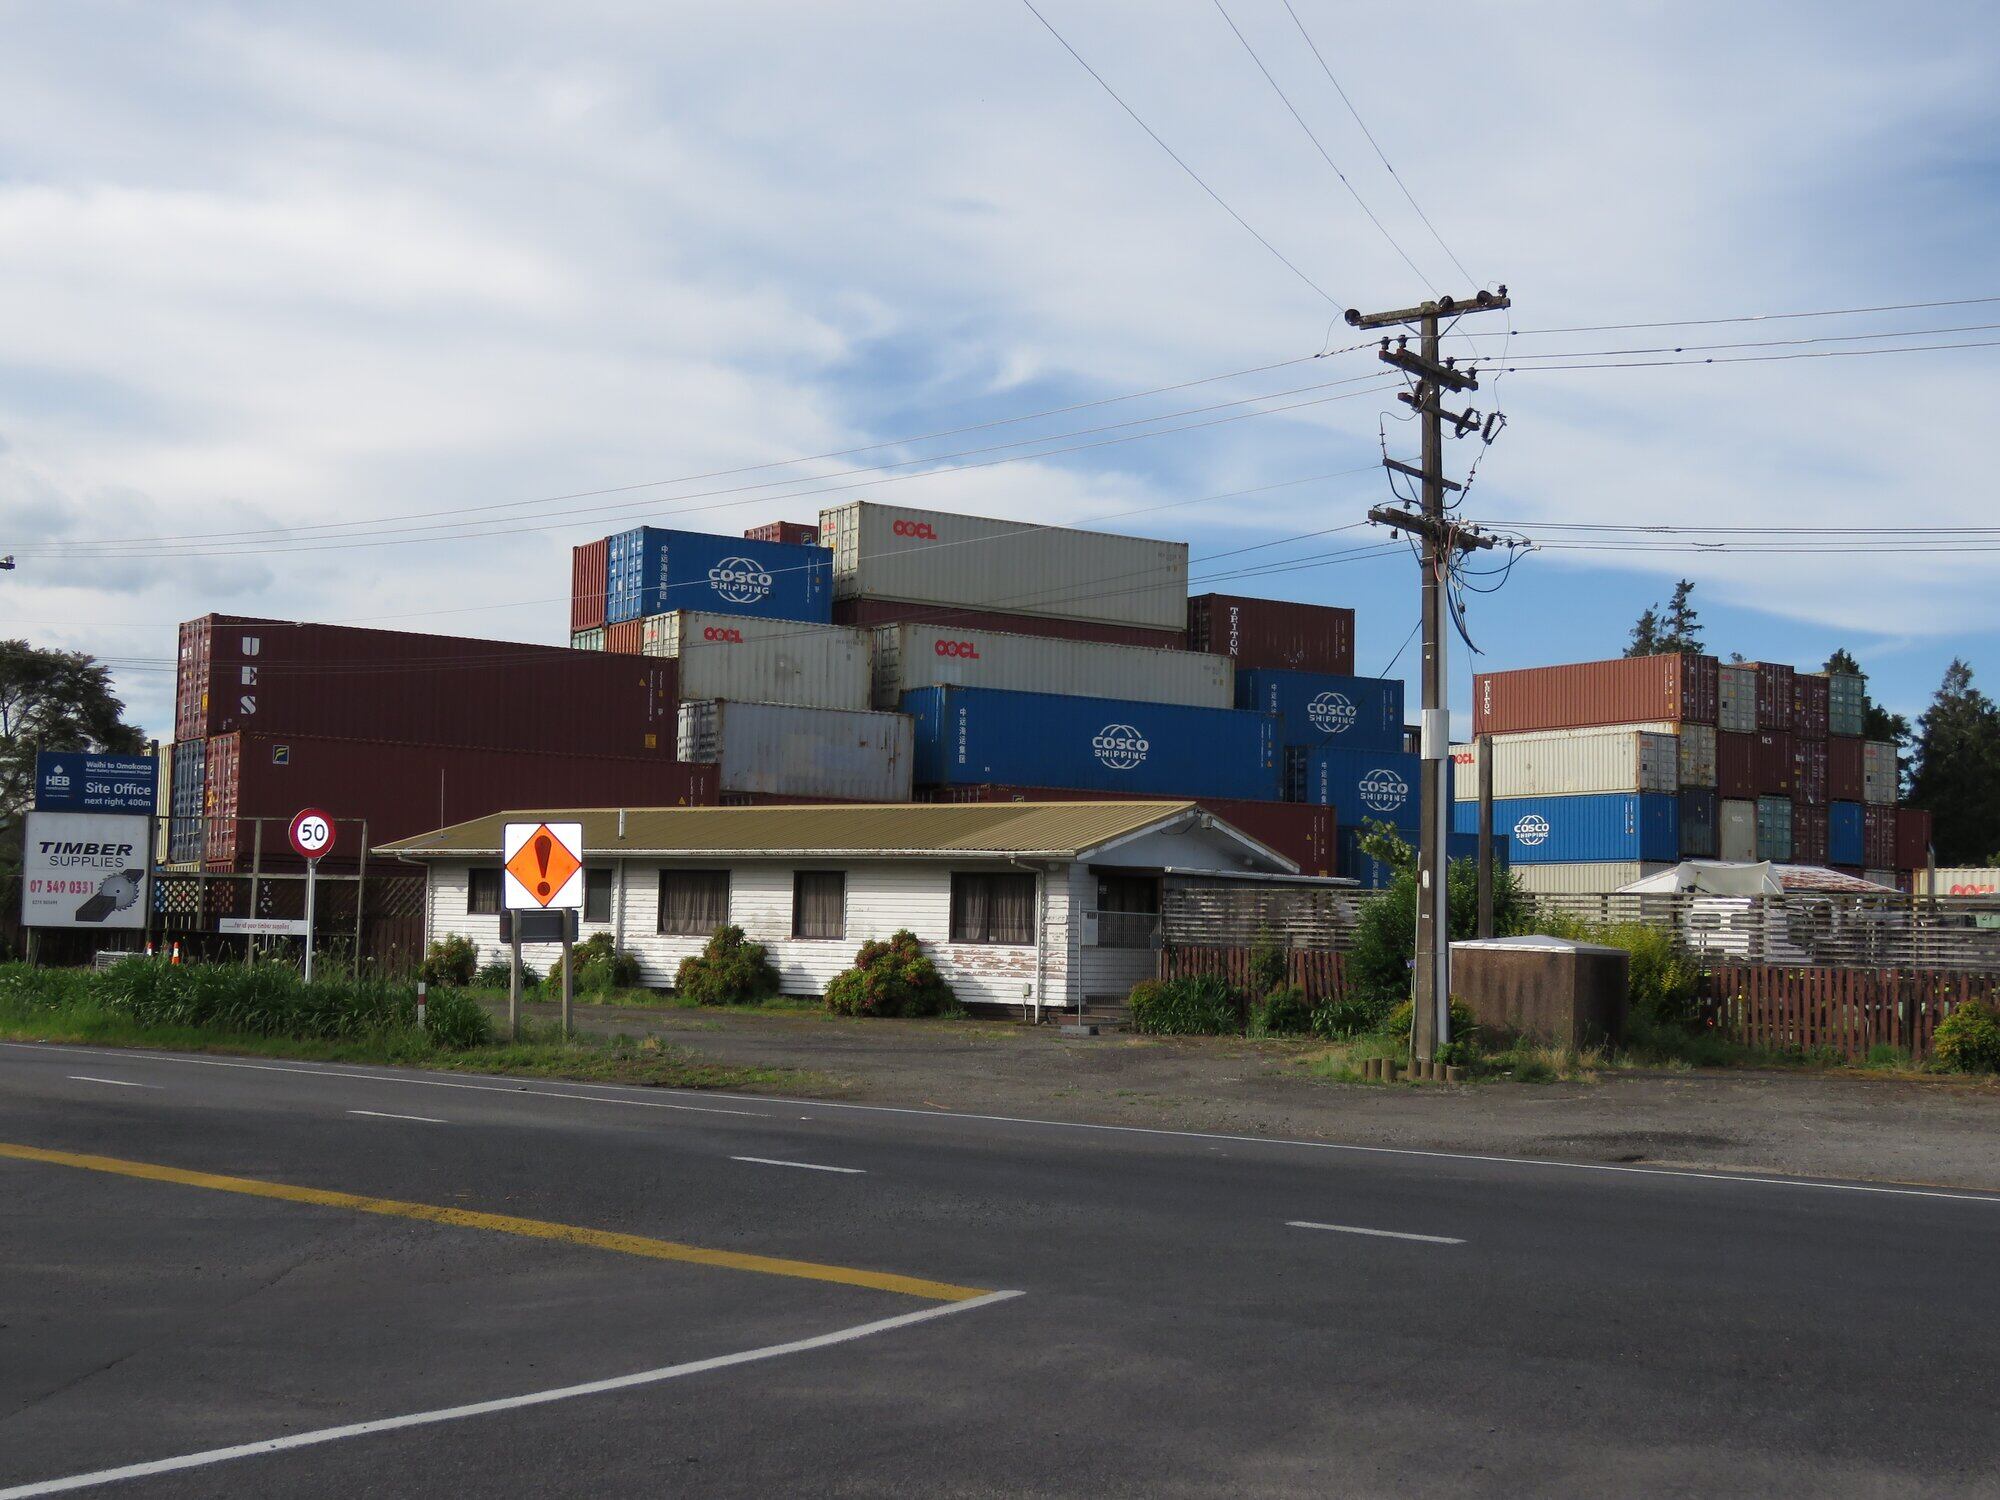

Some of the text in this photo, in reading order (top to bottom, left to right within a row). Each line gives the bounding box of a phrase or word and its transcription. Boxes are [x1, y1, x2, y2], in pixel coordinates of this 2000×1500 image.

[893, 520, 937, 540] OOCL
[708, 568, 772, 586] COSCO
[711, 581, 770, 595] SHIPPING
[704, 627, 743, 643] OOCL
[1230, 607, 1239, 655] TRITON
[935, 640, 979, 659] OOCL
[1307, 702, 1356, 716] COSCO
[1309, 714, 1355, 725] SHIPPING
[1092, 736, 1149, 751] COSCO
[1094, 749, 1147, 760] SHIPPING
[1453, 753, 1475, 764] OCL
[86, 761, 106, 769] Waihi
[116, 762, 152, 771] Omokoroa
[46, 776, 70, 786] HEB
[1358, 780, 1408, 794] COSCO
[86, 782, 151, 795] Site Office
[104, 797, 126, 806] right,
[128, 798, 151, 806] 400m
[1360, 793, 1406, 802] SHIPPING
[302, 824, 325, 841] 50
[1513, 823, 1549, 833] COSCO
[39, 842, 133, 856] TIMBER
[49, 855, 124, 867] SUPPLIES
[30, 880, 93, 894] 07 549 0331
